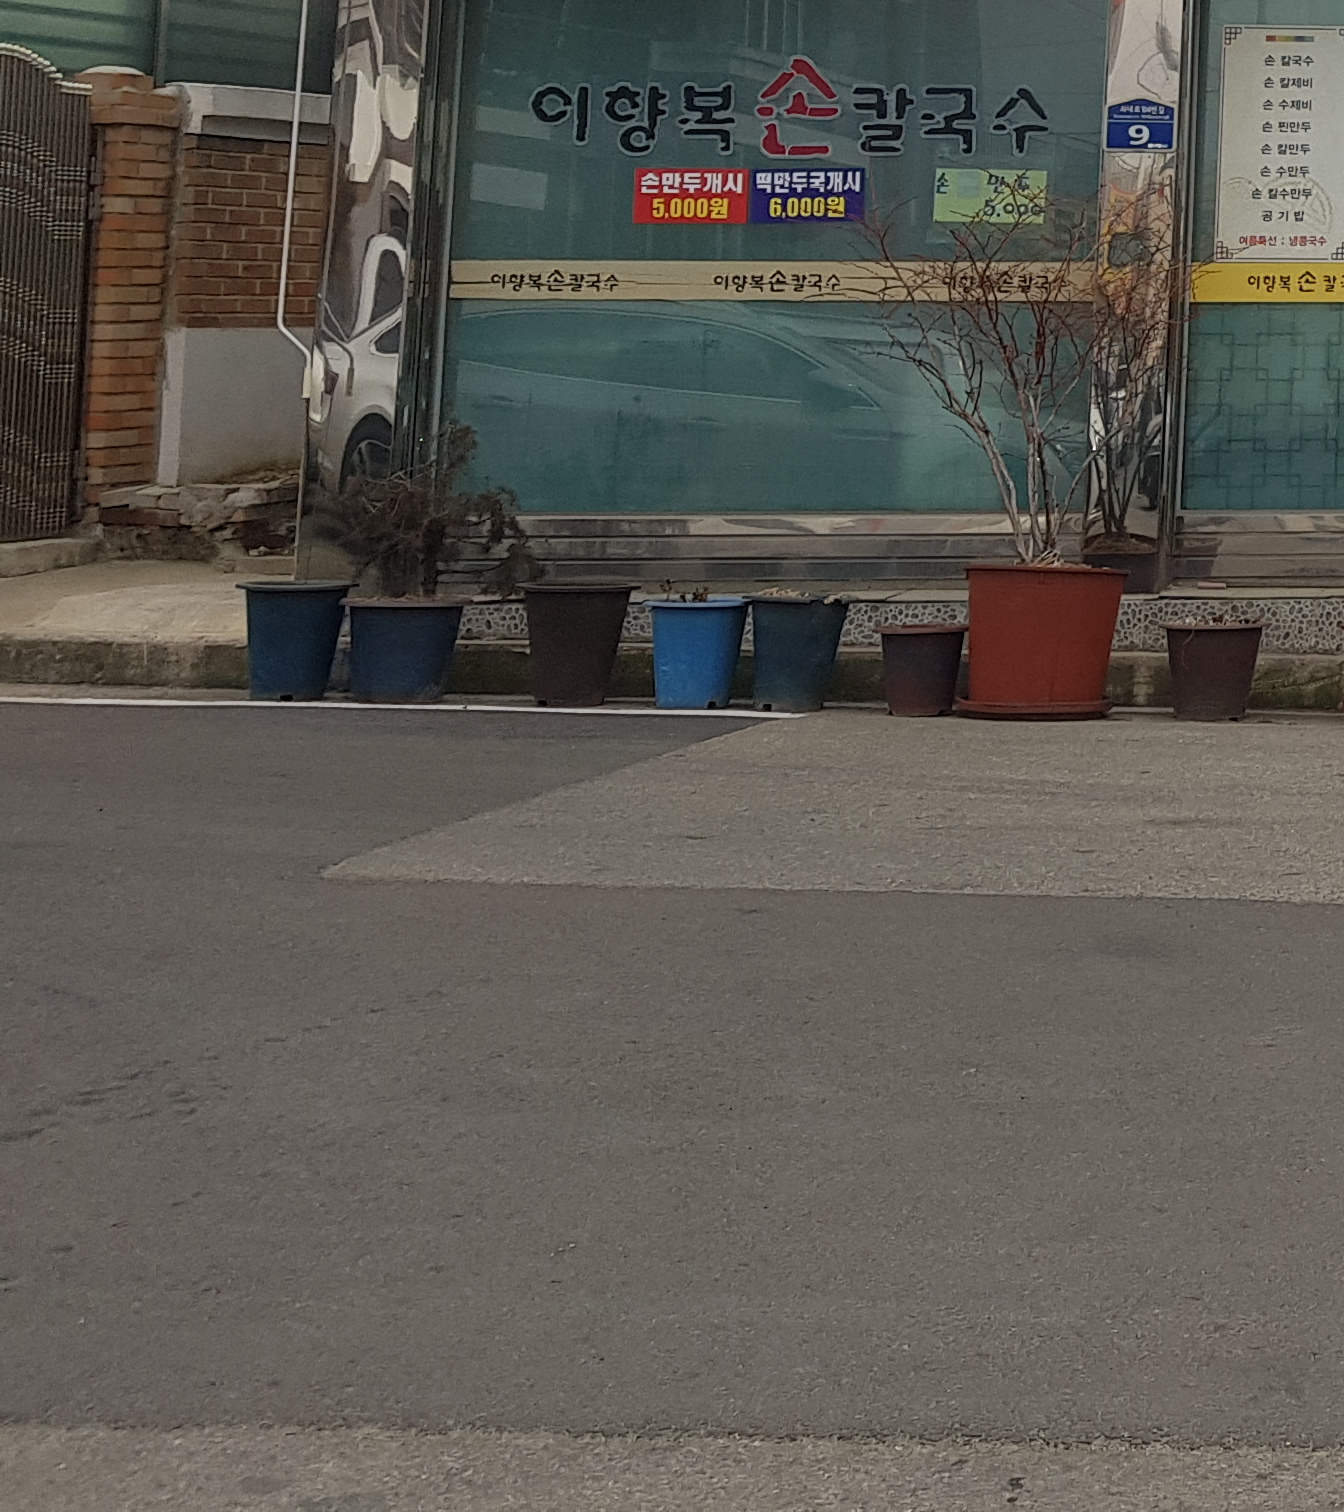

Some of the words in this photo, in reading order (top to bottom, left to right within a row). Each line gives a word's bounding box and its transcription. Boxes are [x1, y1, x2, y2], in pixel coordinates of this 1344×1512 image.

[1264, 55, 1275, 66] 손
[1281, 55, 1314, 67] 칼국수
[1264, 77, 1274, 88] 손
[1279, 77, 1313, 89] 칼제비
[1262, 100, 1273, 111] 손
[1278, 99, 1312, 111] 수제비
[1262, 122, 1273, 133] 손
[1128, 124, 1149, 145] 9
[1261, 144, 1272, 155] 손
[1260, 166, 1271, 177] 손
[1276, 166, 1310, 178] 수만두
[640, 172, 743, 194] 손만두개시
[755, 172, 861, 192] 떡만두국개시
[936, 172, 949, 194] 손
[1252, 188, 1262, 199] 손
[652, 197, 728, 219] 5,000원
[769, 196, 845, 218] 6,000원
